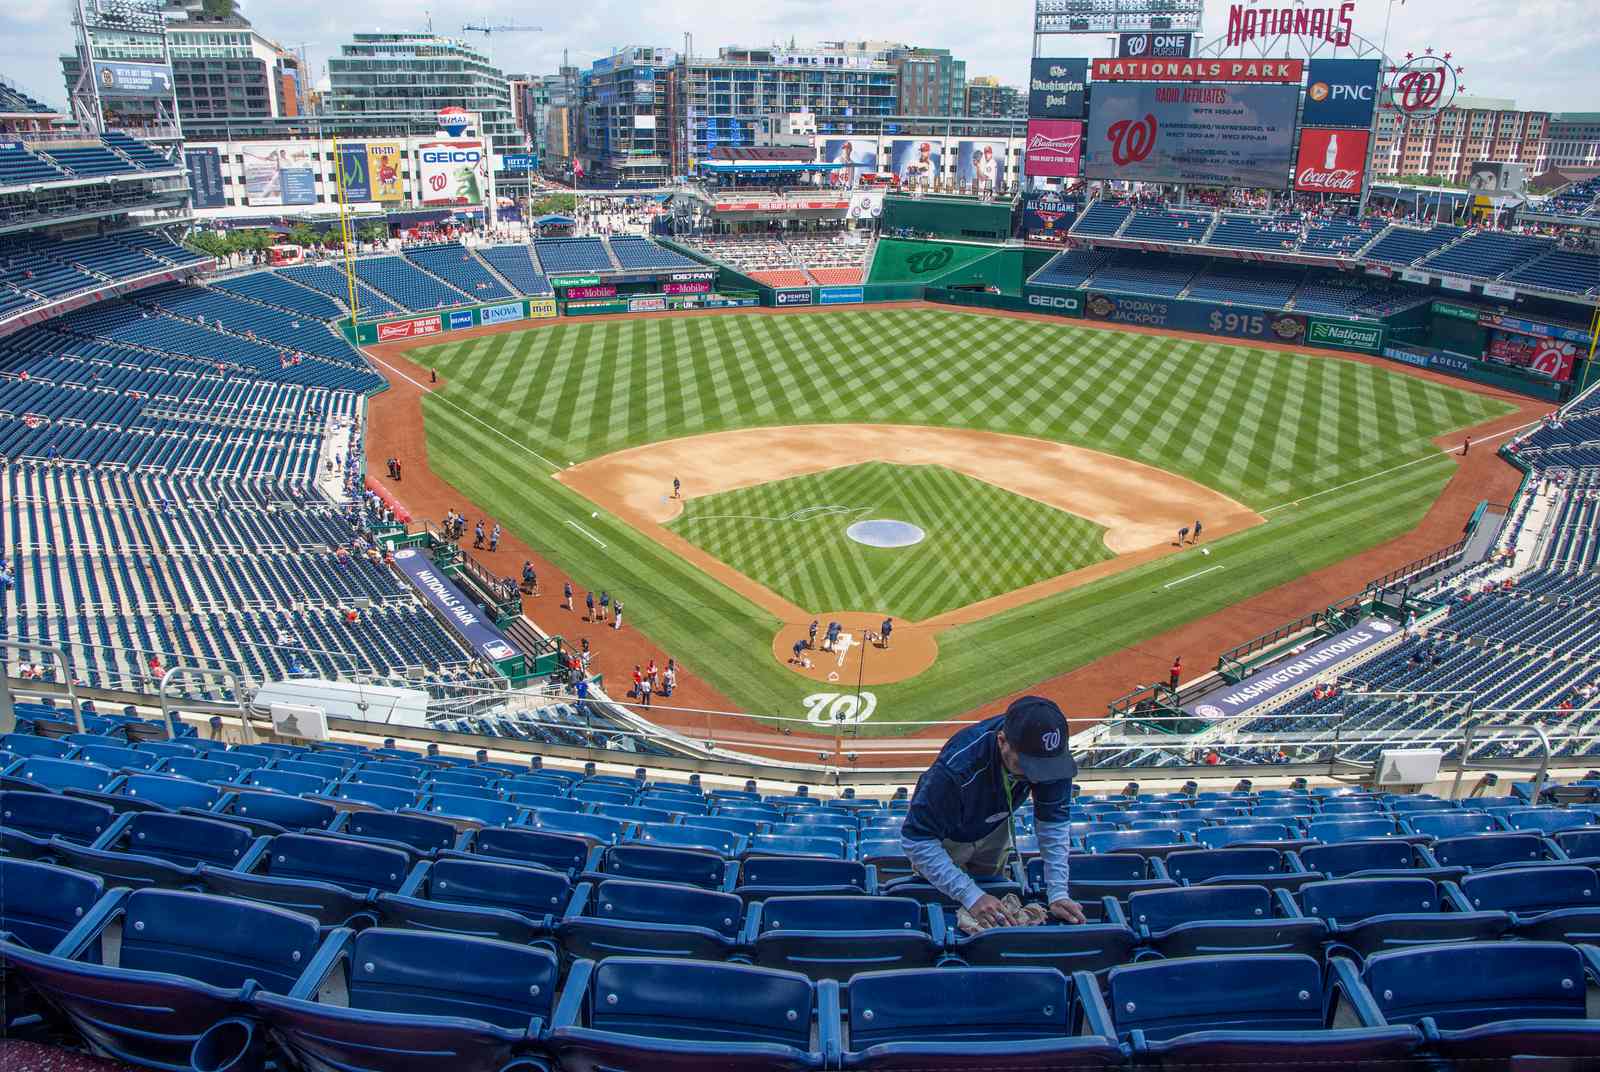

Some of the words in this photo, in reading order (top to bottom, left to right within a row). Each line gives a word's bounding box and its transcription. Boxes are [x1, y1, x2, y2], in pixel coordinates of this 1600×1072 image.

[1227, 3, 1354, 47] NATIONALS
[1154, 36, 1185, 48] ONE
[1153, 48, 1184, 56] PURSUIT
[1050, 65, 1067, 77] The
[1099, 62, 1220, 77] NATIONALS
[1232, 64, 1290, 77] PARK
[1032, 78, 1084, 93] Washington
[1331, 84, 1373, 100] PNC
[1046, 95, 1066, 109] Post
[1156, 87, 1180, 102] RADIO
[1183, 88, 1226, 104] AFFILIATES
[423, 152, 480, 163] GEICO
[1026, 202, 1039, 211] ALL
[1040, 202, 1056, 212] STAR
[1057, 203, 1075, 213] GAME
[1028, 294, 1077, 309] GEICO
[1117, 299, 1168, 314] TODAY'S
[490, 306, 517, 318] INOVA
[1113, 313, 1167, 325] JACKPOT
[1209, 309, 1264, 335] $915
[1328, 325, 1377, 343] National
[1440, 358, 1468, 370] DELTA
[416, 569, 459, 607] NATIONALS
[451, 603, 480, 626] PARK
[1222, 660, 1312, 706] WASHINGTON
[1306, 631, 1373, 667] NATIONALS
